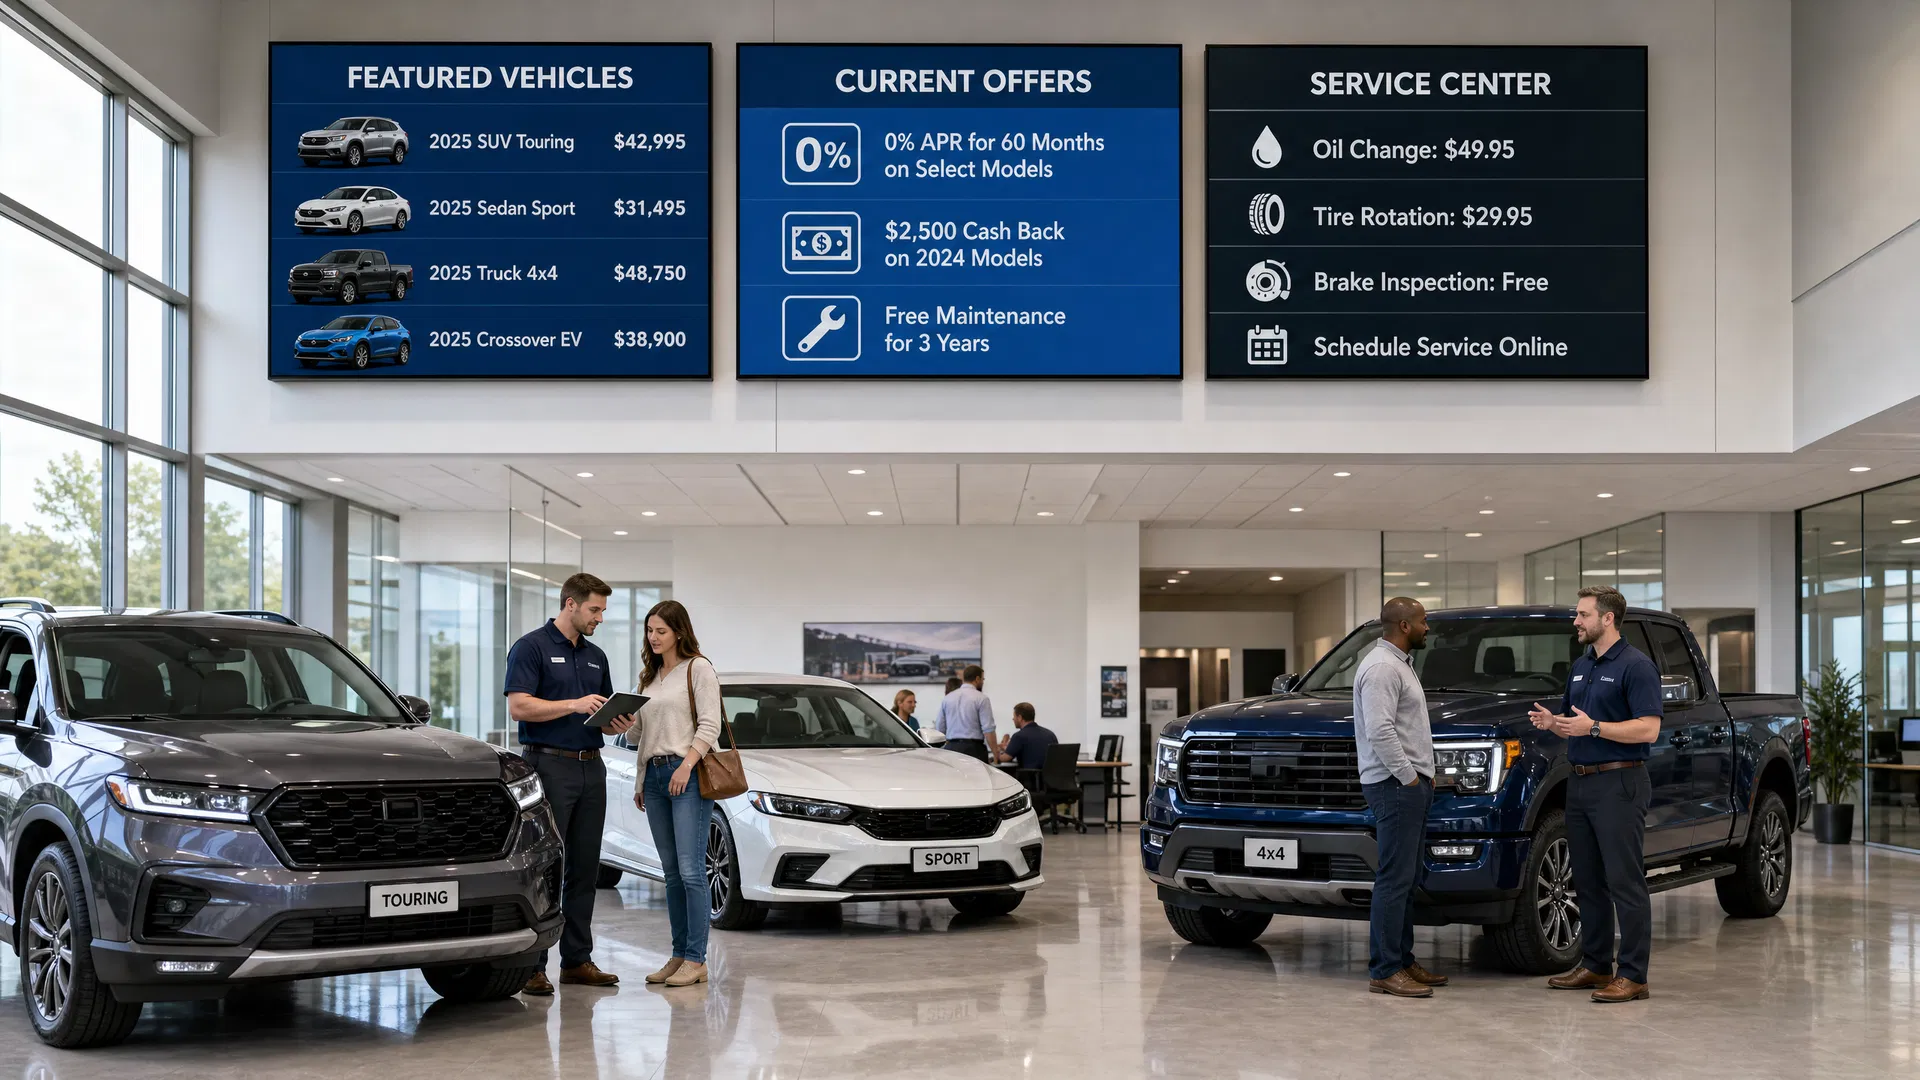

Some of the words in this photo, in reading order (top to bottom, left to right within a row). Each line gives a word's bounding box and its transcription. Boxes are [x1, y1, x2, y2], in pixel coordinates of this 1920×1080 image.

[349, 67, 492, 88] FEATURED
[500, 66, 633, 88] VEHICLES
[836, 69, 974, 92] CURRENT
[983, 69, 1091, 93] OFFERS
[1311, 72, 1430, 95] SERVICE
[1440, 72, 1551, 95] CENTER
[430, 134, 471, 148] 2025
[478, 134, 512, 148] SUV
[516, 134, 574, 153] Touring
[615, 132, 685, 151] $42,995
[885, 133, 914, 150] 0%
[920, 133, 962, 150] APR
[968, 132, 995, 150] for
[1002, 133, 1025, 150] 60
[1033, 132, 1104, 151] Months
[1313, 139, 1342, 158] Oil
[1350, 139, 1436, 164] Change:
[1445, 138, 1514, 161] $49.95
[796, 137, 851, 172] 0%
[885, 165, 908, 177] on
[916, 159, 975, 177] Select
[983, 159, 1053, 177] Models
[430, 200, 471, 215] 2025
[478, 200, 526, 215] Sedan
[532, 200, 575, 219] Sport
[614, 199, 685, 217] $31,495
[1313, 207, 1354, 226] Tire
[1362, 207, 1454, 226] Rotation:
[1463, 205, 1532, 228] $29.95
[886, 220, 956, 242] $2,500
[963, 221, 1010, 240] Cash
[1019, 221, 1064, 240] Back
[885, 254, 909, 266] on
[917, 249, 965, 266] 2024
[972, 248, 1042, 266] Models
[430, 265, 471, 280] 2025
[477, 265, 521, 280] Truck
[527, 266, 557, 280] 4x4
[614, 264, 686, 282] $48,750
[1315, 272, 1374, 291] Brake
[1382, 272, 1494, 296] Inspection:
[1503, 272, 1548, 291] Free
[886, 306, 929, 324] Free
[937, 306, 1065, 324] Maintenance
[430, 332, 471, 346] 2025
[477, 332, 556, 346] Crossover
[562, 332, 582, 346] EV
[614, 330, 686, 349] $38,900
[885, 333, 912, 351] for
[919, 334, 930, 351] 3
[937, 334, 989, 351] Years
[1315, 336, 1410, 356] Schedule
[1418, 337, 1492, 356] Service
[1500, 337, 1567, 356] Online
[924, 851, 971, 867] SPORT
[1257, 846, 1285, 860] 4x4
[382, 891, 447, 907] TOURING
